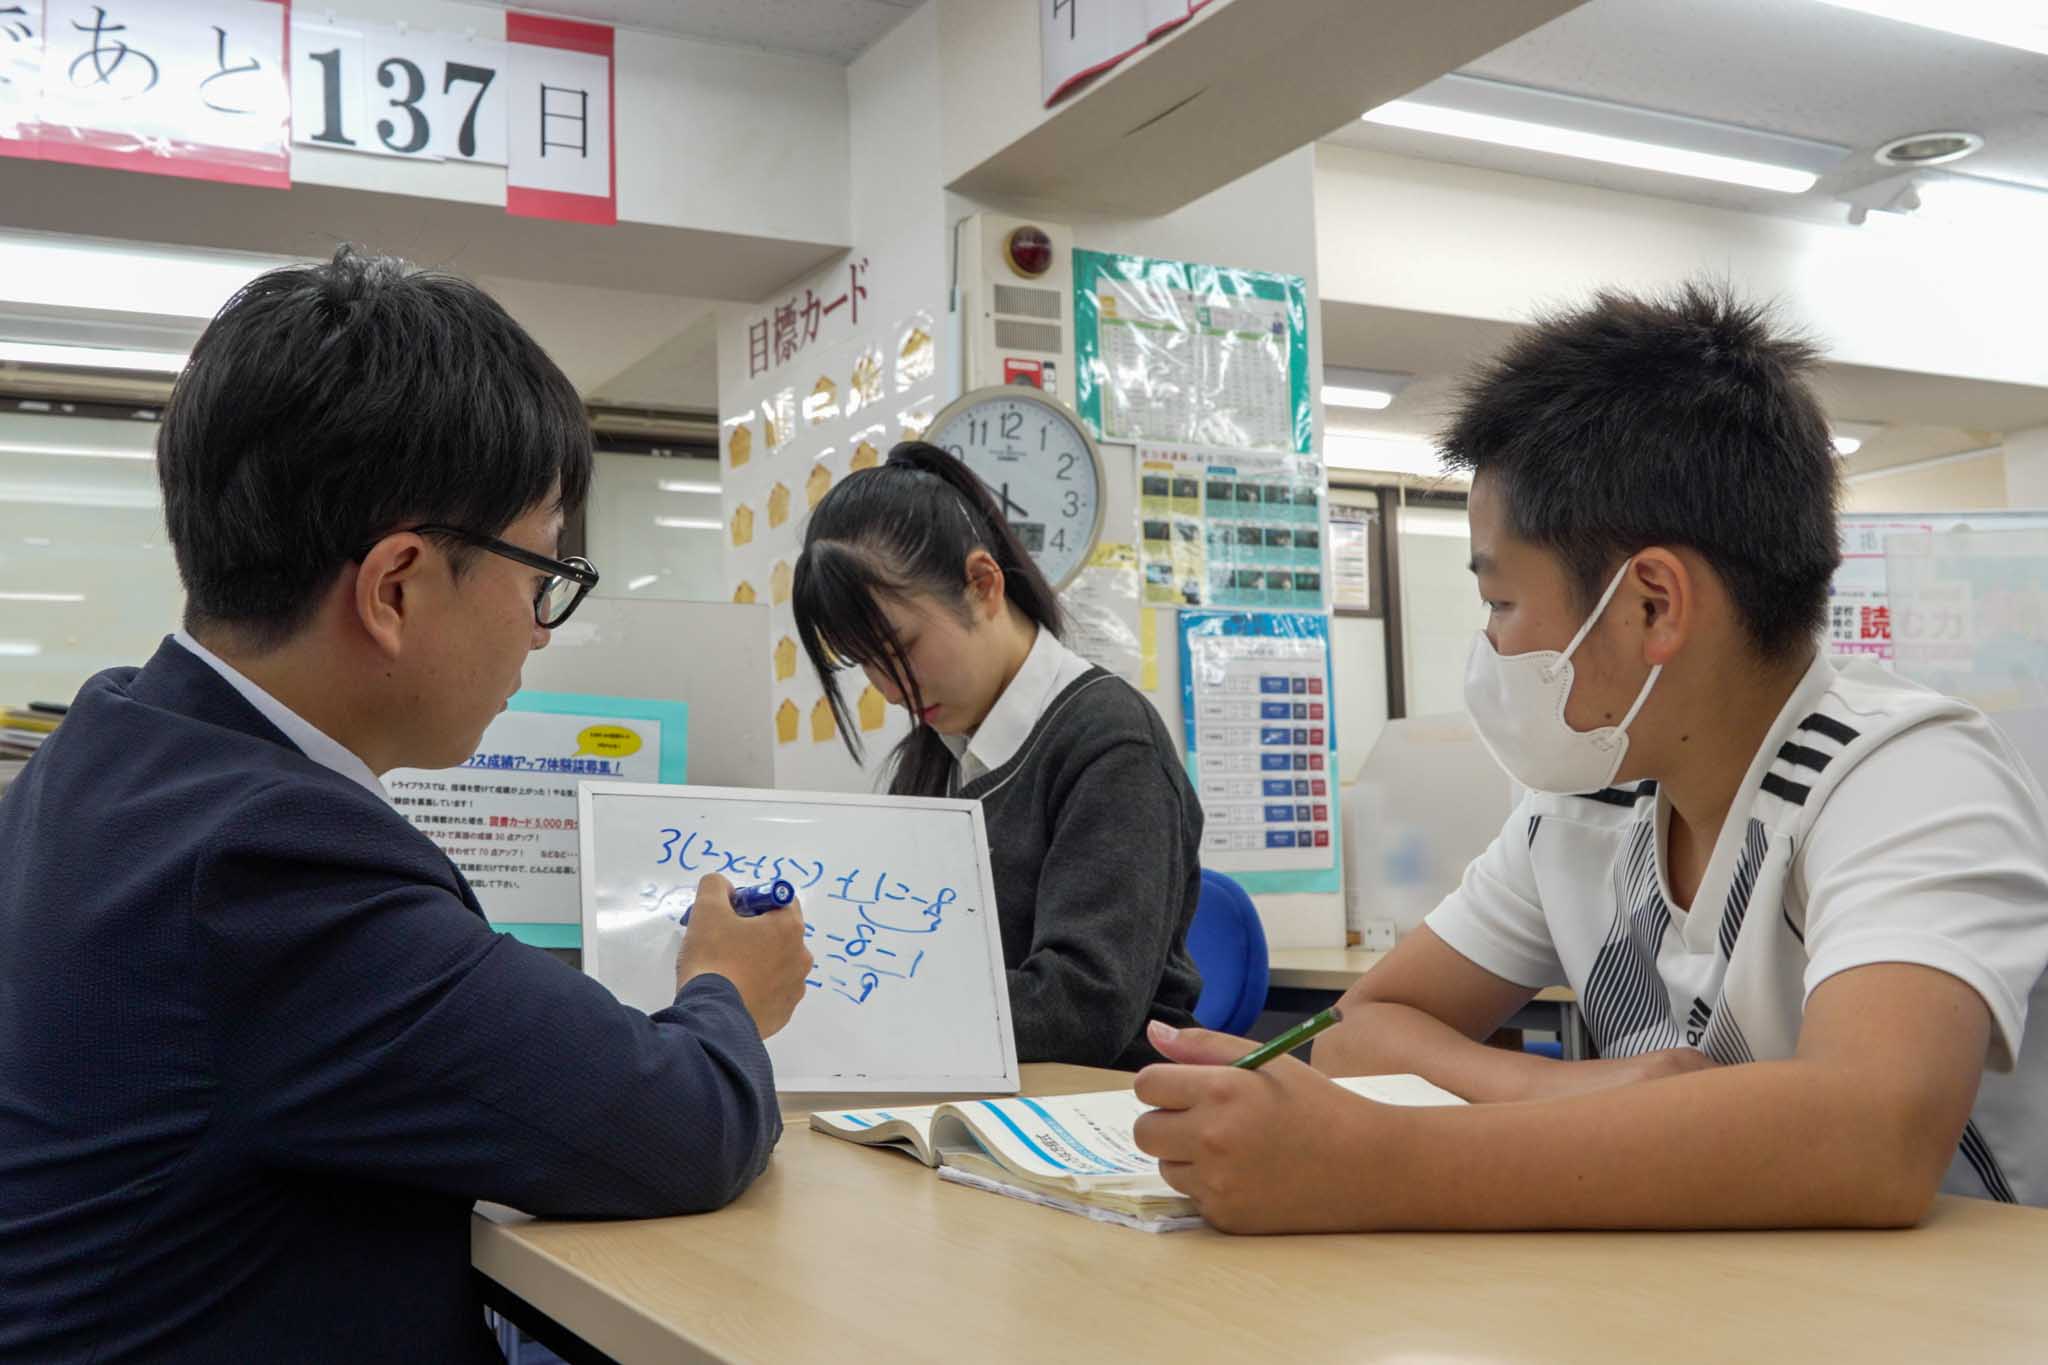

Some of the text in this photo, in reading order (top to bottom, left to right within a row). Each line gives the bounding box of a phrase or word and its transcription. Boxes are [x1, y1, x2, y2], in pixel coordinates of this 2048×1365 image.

[749, 257, 869, 379] 目標カード
[969, 420, 988, 446] 11
[1000, 411, 1023, 439] 12
[1040, 425, 1047, 451] 1
[1056, 452, 1074, 480] 2
[1062, 491, 1079, 517] 3
[1050, 527, 1066, 552] 4
